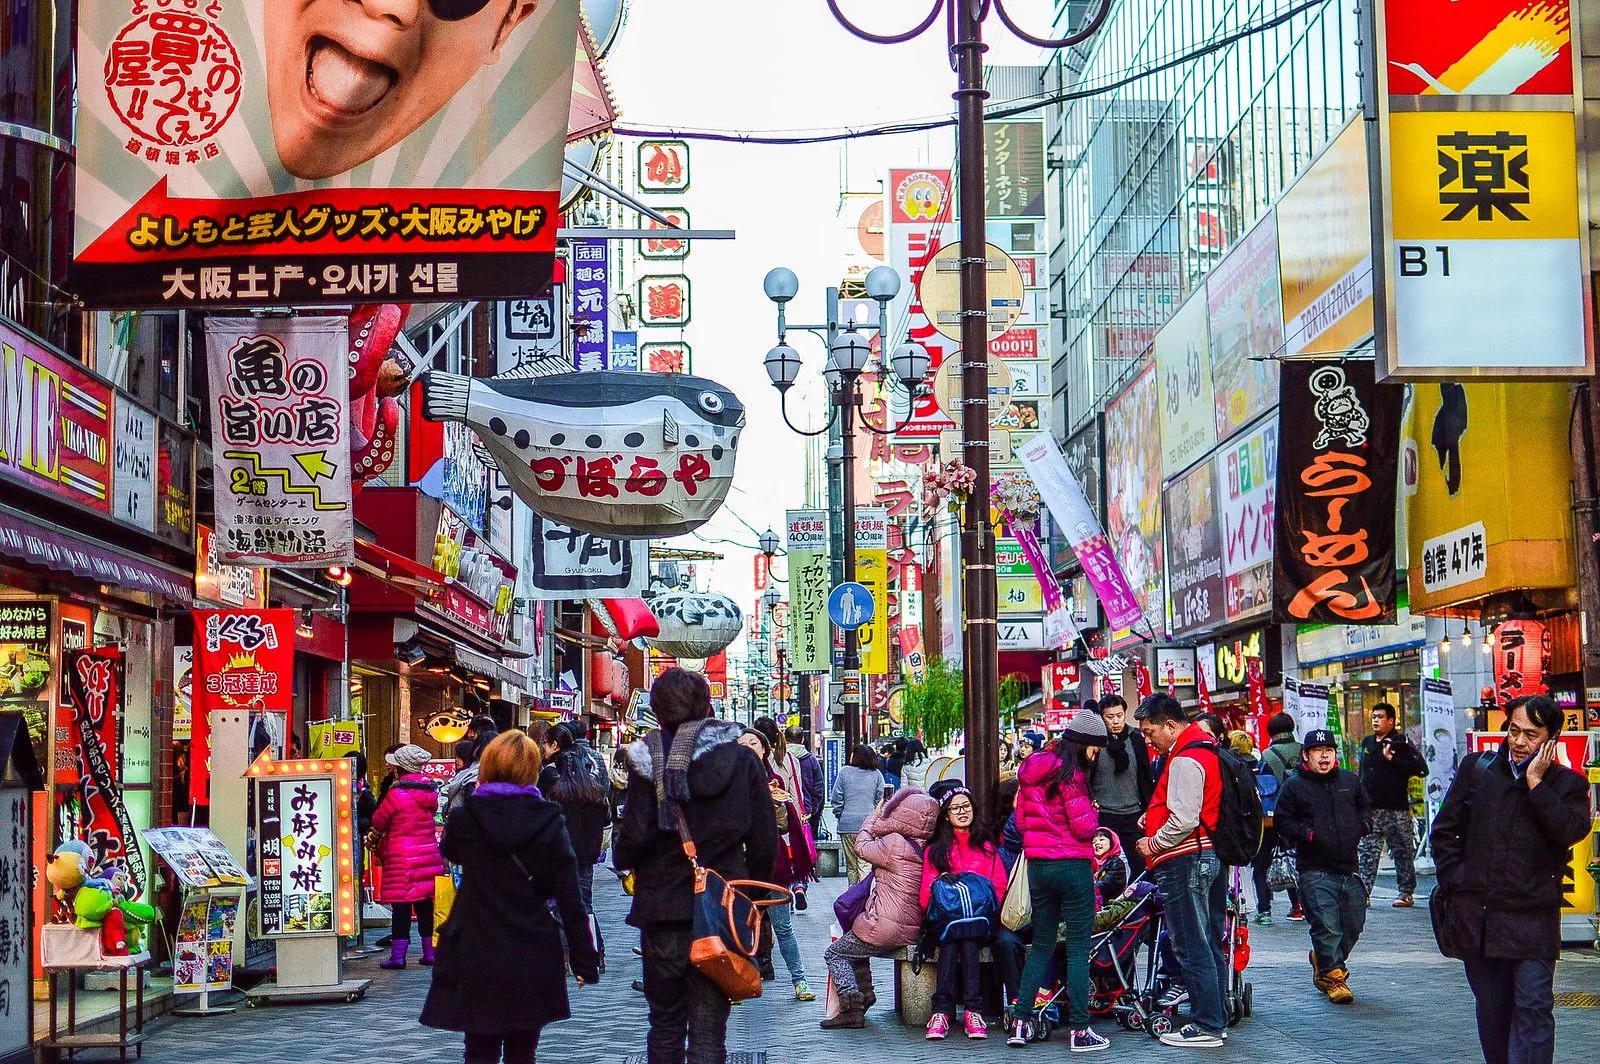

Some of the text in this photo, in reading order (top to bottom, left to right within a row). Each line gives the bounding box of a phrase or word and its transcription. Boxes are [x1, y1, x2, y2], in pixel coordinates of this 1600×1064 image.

[125, 137, 221, 166] 道頓堀本店
[993, 124, 1013, 215] インターネット
[1437, 131, 1530, 221] 薬
[129, 206, 542, 247] よしもと芸人グッズ・大阪みやげ
[577, 246, 604, 261] 元祖
[1400, 245, 1451, 277] B1
[409, 262, 460, 294] 선물
[511, 300, 550, 329] 牛角
[231, 339, 325, 398] 魚の
[0, 343, 60, 484] ME
[225, 400, 339, 442] 旨い店
[61, 415, 107, 466] NIKO-NIKO
[530, 453, 711, 499] づぼらや
[1228, 426, 1276, 500] カラオケ
[231, 470, 267, 496] 2階
[127, 490, 140, 520] 4F
[236, 496, 308, 509] ゲームセンター上
[227, 528, 328, 554] 海鮮物語
[789, 520, 824, 532] 道頓堀
[789, 531, 824, 542] 400周年
[1287, 451, 1382, 620] らーめん
[1423, 531, 1485, 585] 創業 47年
[1008, 587, 1025, 604] 柚
[801, 565, 816, 664] チャリンコ通りぬけ
[206, 673, 278, 695] 3冠達成
[262, 817, 281, 857] 一明
[289, 782, 323, 893] お好み焼
[263, 917, 279, 925] B1F
[210, 942, 231, 956] 大阪
